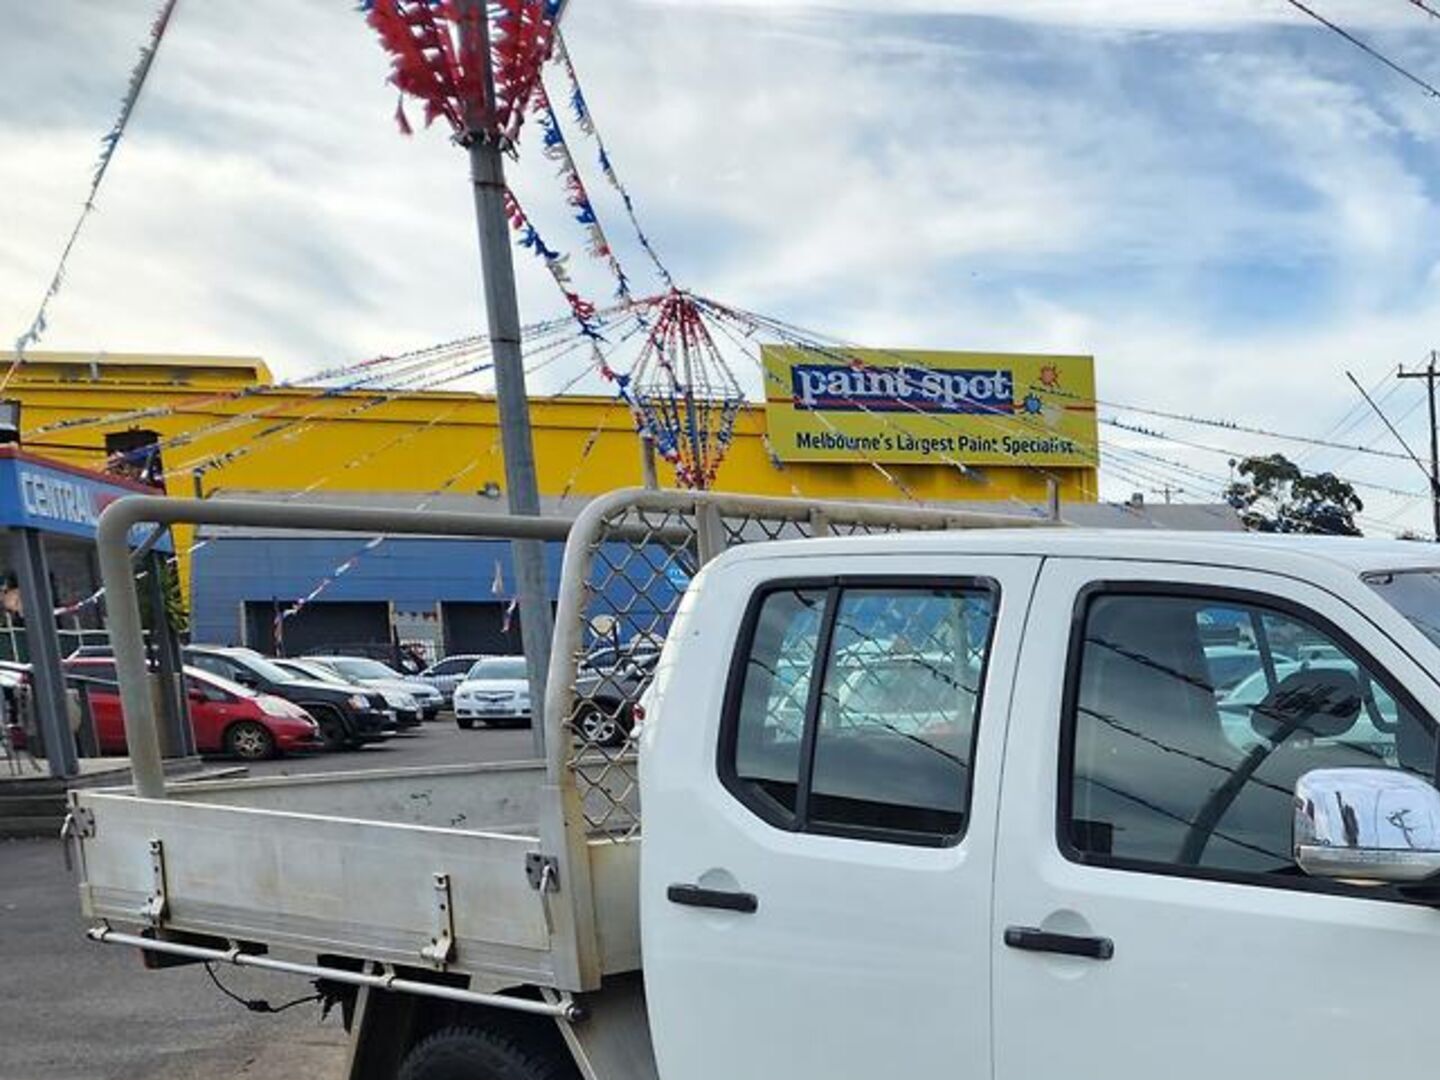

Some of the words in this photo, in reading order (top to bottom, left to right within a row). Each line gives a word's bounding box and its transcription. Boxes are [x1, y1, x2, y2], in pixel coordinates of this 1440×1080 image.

[797, 363, 912, 405] paint
[920, 369, 1012, 409] spot
[796, 432, 892, 451] Melbourne's
[897, 433, 954, 455] Largest
[958, 435, 998, 453] Paint
[1002, 435, 1074, 457] Specialist
[20, 471, 100, 527] CENTRAL
